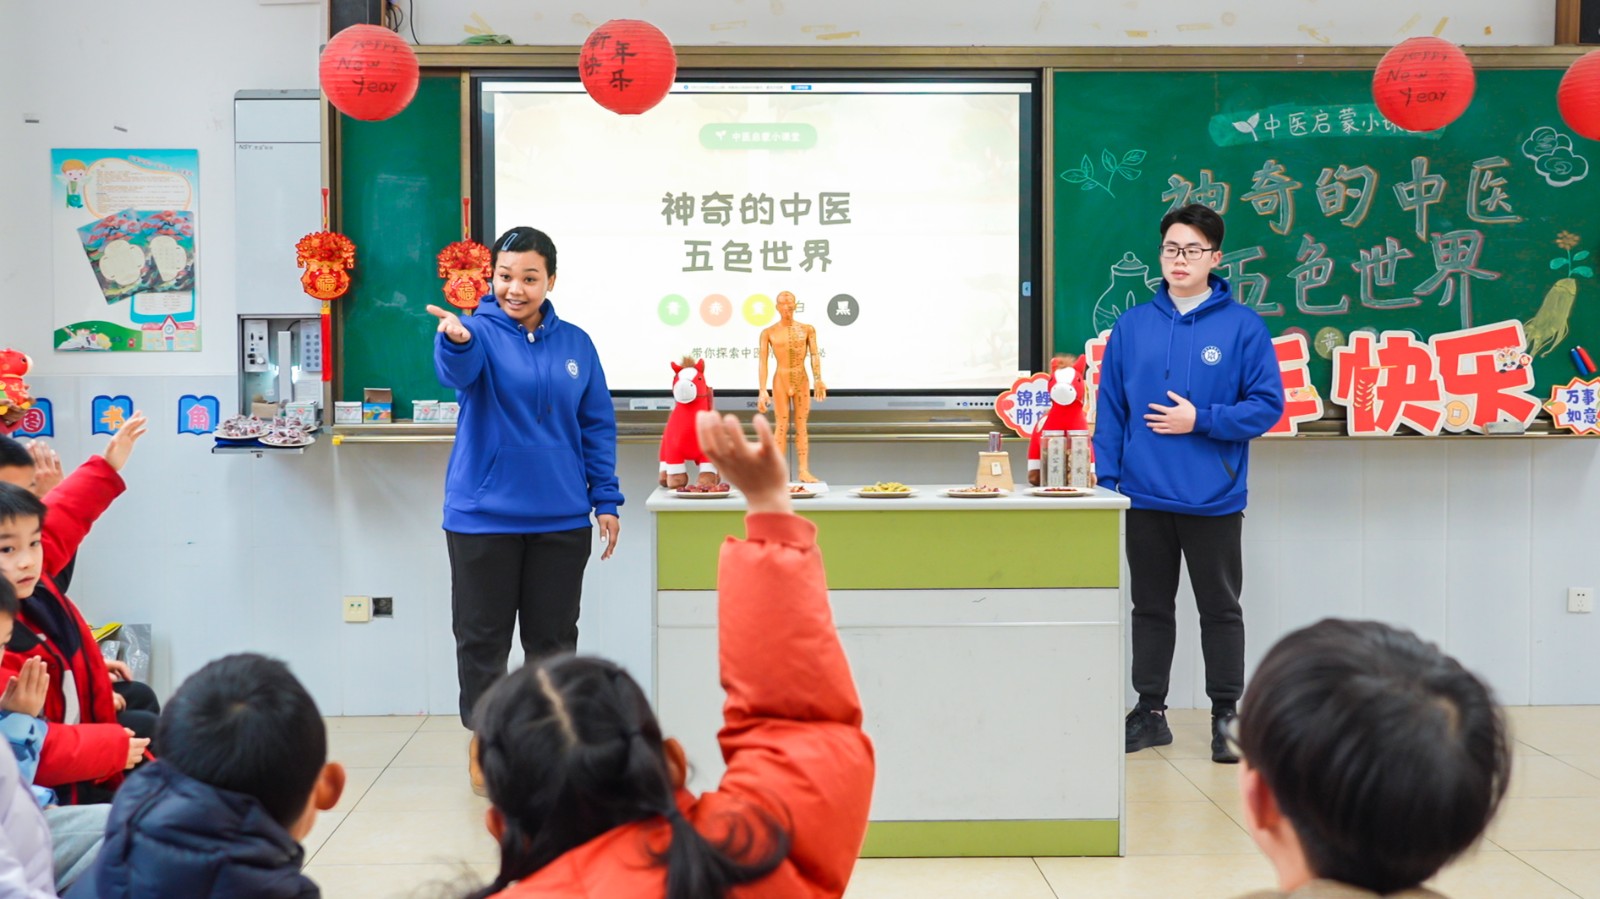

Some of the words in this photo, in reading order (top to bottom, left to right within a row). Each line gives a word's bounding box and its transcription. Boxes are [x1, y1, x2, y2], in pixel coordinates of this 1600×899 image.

[352, 76, 398, 96] Year
[1400, 87, 1446, 108] Year
[1264, 108, 1426, 138] 中医启蒙小
[661, 191, 852, 227] 神奇的中医
[1161, 156, 1523, 242] 神奇的中医
[681, 239, 833, 273] 五色世界
[1215, 229, 1501, 331] 五色世界
[835, 300, 851, 316] 黑
[1321, 332, 1339, 353] 黄
[1016, 390, 1051, 407] 锦鲤
[1566, 389, 1595, 405] 万事
[101, 406, 125, 430] 书
[188, 404, 209, 430] 角
[1566, 407, 1598, 424] 如意
